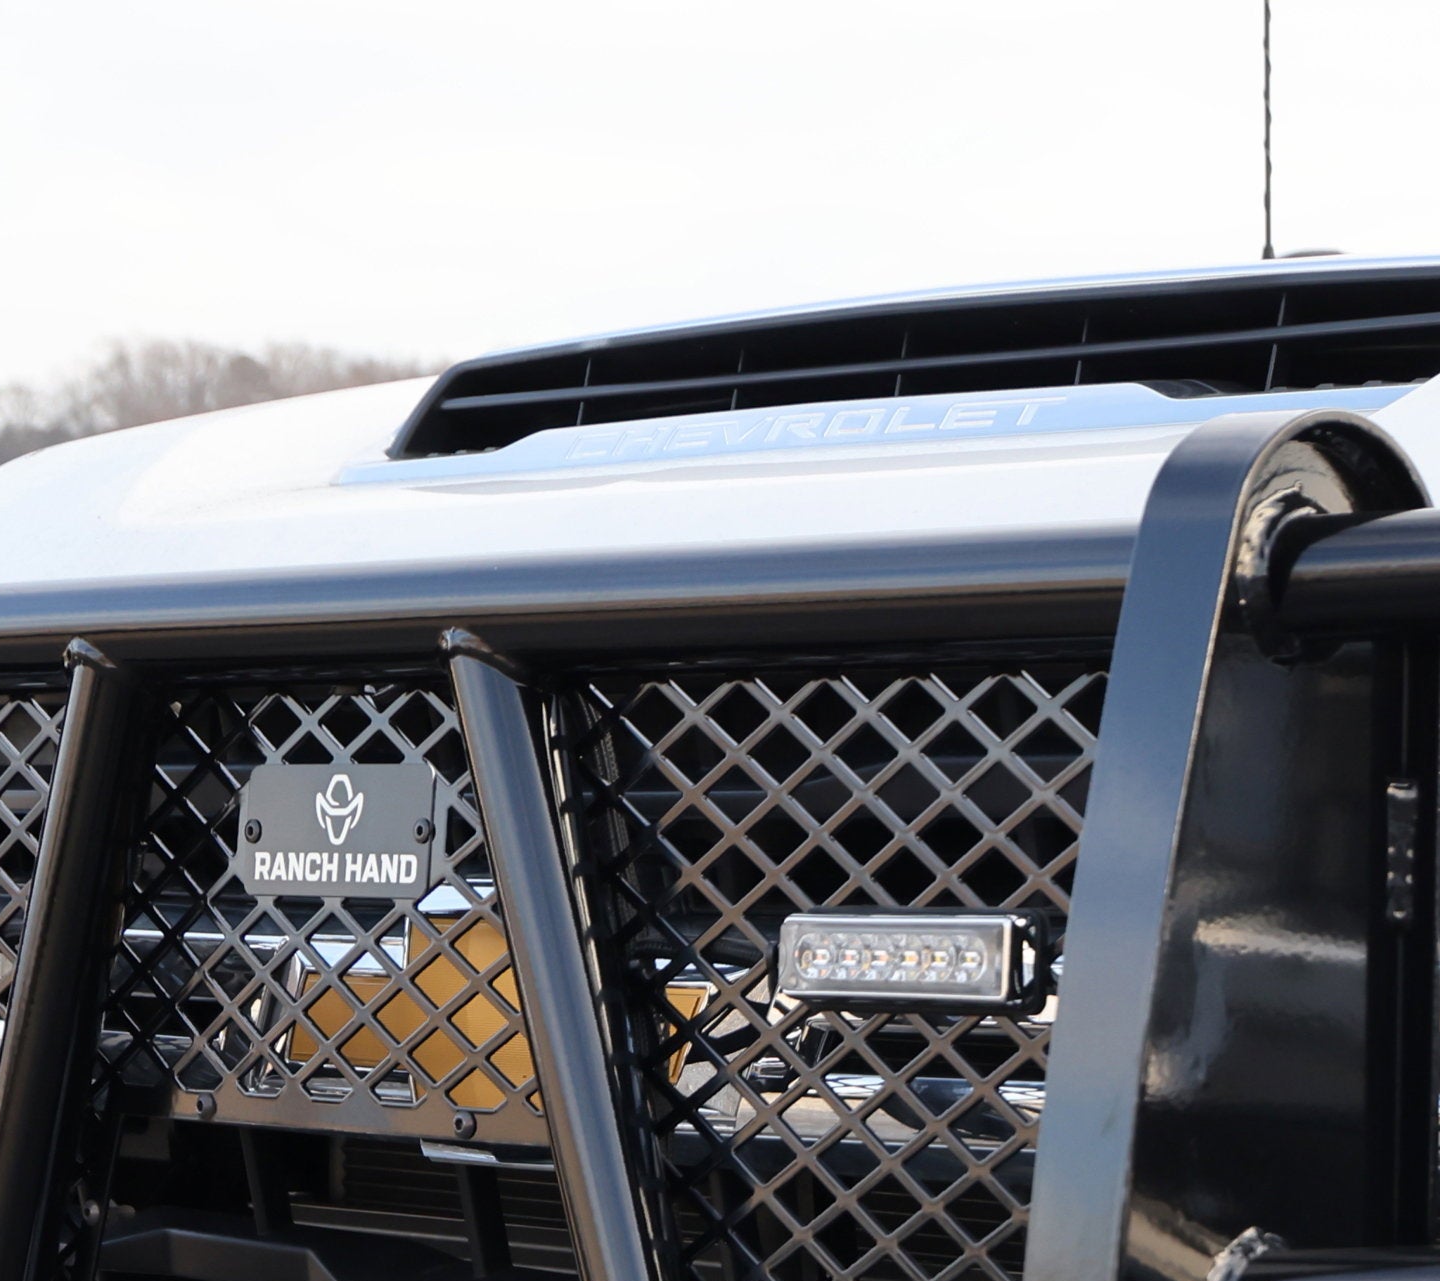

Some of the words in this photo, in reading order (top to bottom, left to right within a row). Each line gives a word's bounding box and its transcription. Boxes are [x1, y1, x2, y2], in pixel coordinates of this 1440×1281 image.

[565, 396, 1067, 461] CHEVROLET
[254, 851, 339, 882] RANCH
[345, 853, 418, 884] HAND
